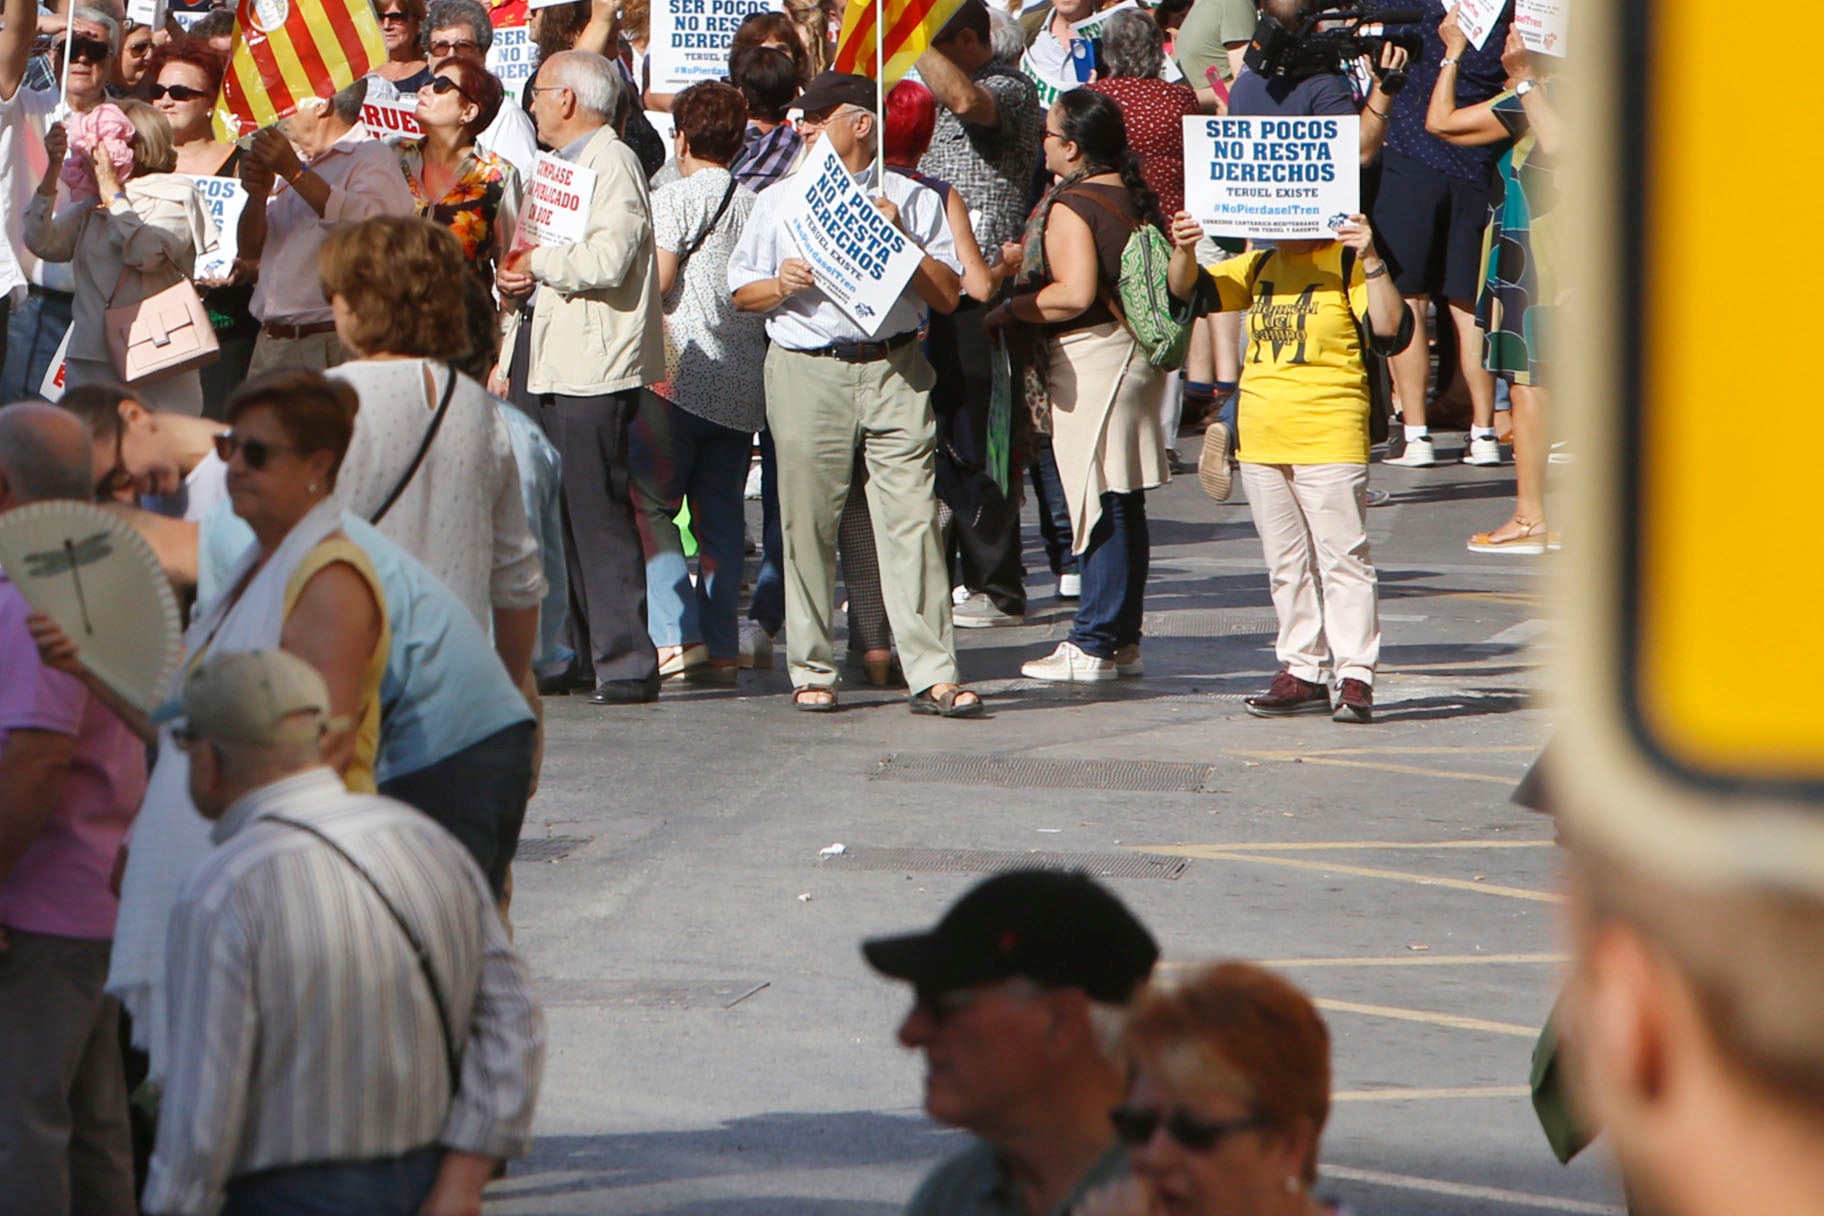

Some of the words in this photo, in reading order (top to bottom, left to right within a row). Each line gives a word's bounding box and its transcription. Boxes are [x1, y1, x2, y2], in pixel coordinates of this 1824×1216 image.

[669, 0, 705, 14] SER
[712, 0, 770, 14] POCOS
[674, 16, 701, 32] NO
[493, 32, 526, 46] SER
[498, 47, 521, 63] NO
[684, 53, 719, 62] TERUEL
[1206, 120, 1261, 139] SER
[1265, 120, 1338, 140] POCOS
[1214, 142, 1246, 160] NO
[1252, 142, 1332, 161] RESTA
[1210, 162, 1335, 183] DERECHOS
[1226, 187, 1272, 198] TERUEL
[1276, 188, 1319, 198] EXISTE
[824, 150, 850, 196] SER
[849, 191, 906, 253] POCOS
[1214, 203, 1320, 215] #NoPierdaselTren
[816, 173, 837, 204] NO
[834, 200, 890, 265] RESTA
[805, 184, 886, 281] DERECHOS
[805, 214, 829, 251] TERUEL
[830, 248, 864, 281] EXISTE
